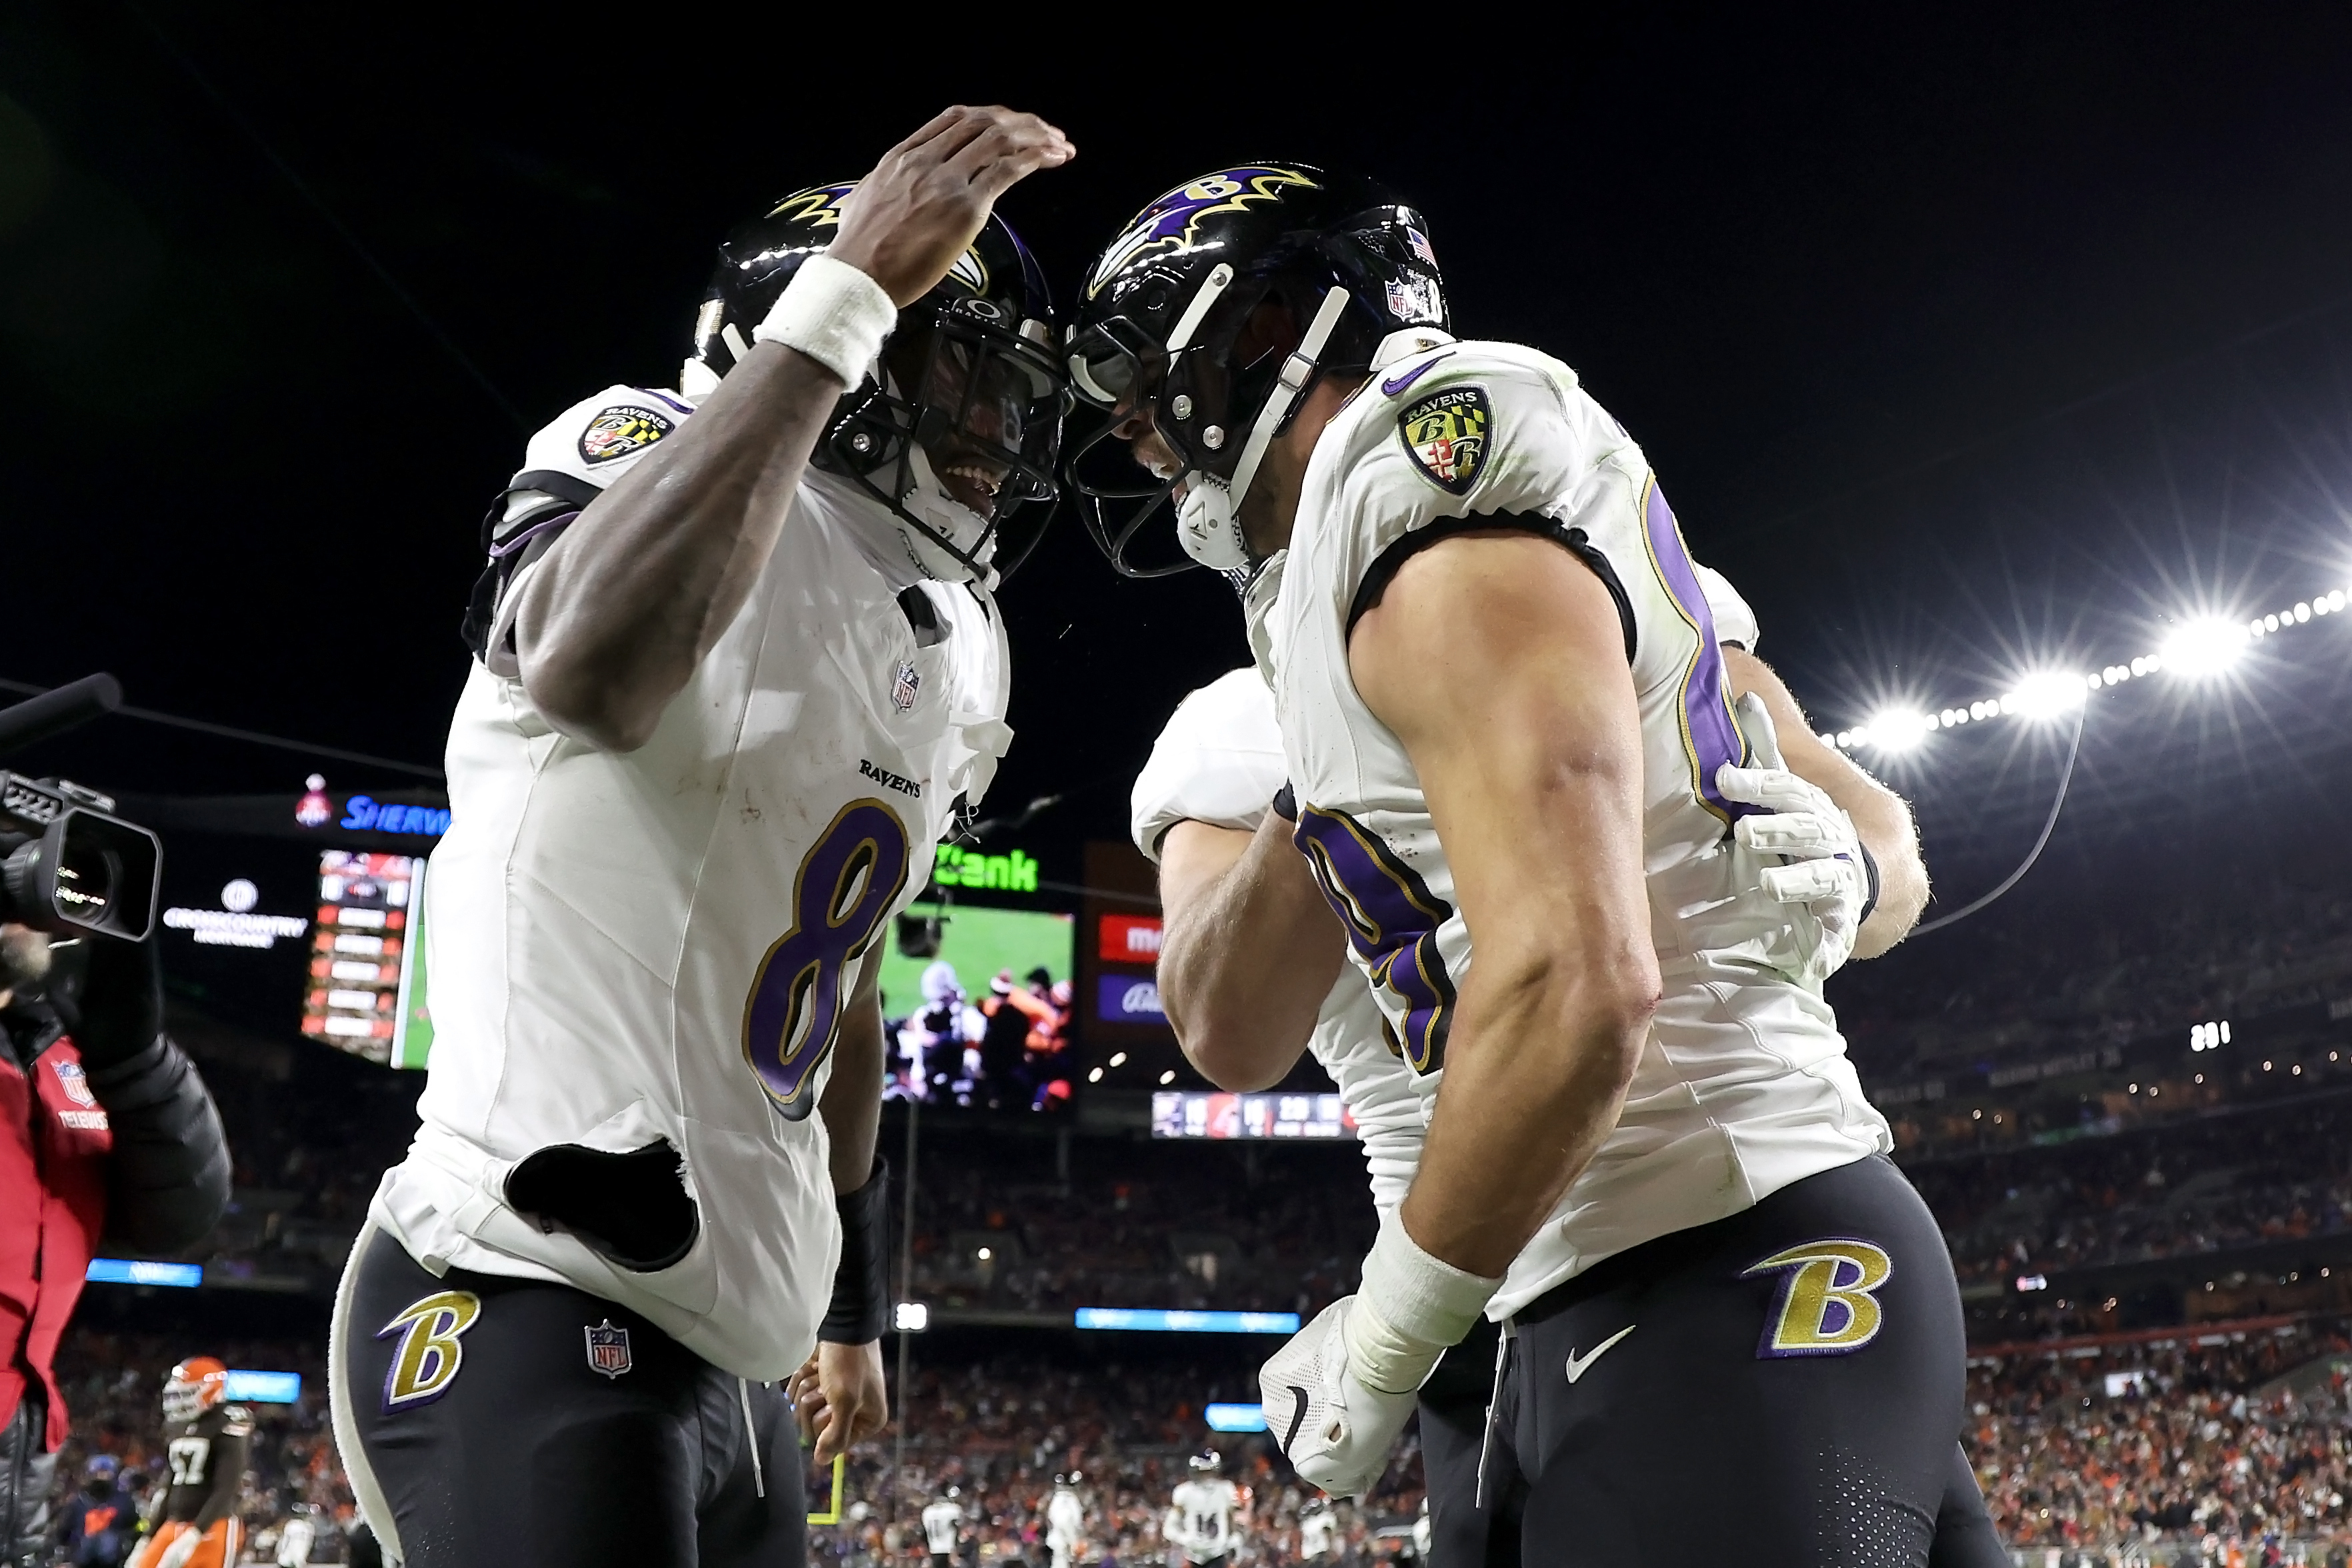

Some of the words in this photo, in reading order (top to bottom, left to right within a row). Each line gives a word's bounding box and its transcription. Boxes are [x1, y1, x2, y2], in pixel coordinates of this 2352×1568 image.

[1391, 295, 1411, 313] NFL
[604, 407, 668, 430] RAVENS
[1406, 391, 1478, 423] RAVENS
[894, 683, 915, 707] NFL
[859, 759, 922, 799] RAVENS
[741, 797, 909, 1121] 8
[1737, 1235, 1895, 1360] B
[373, 1289, 481, 1415] B
[595, 1345, 627, 1367] NFL
